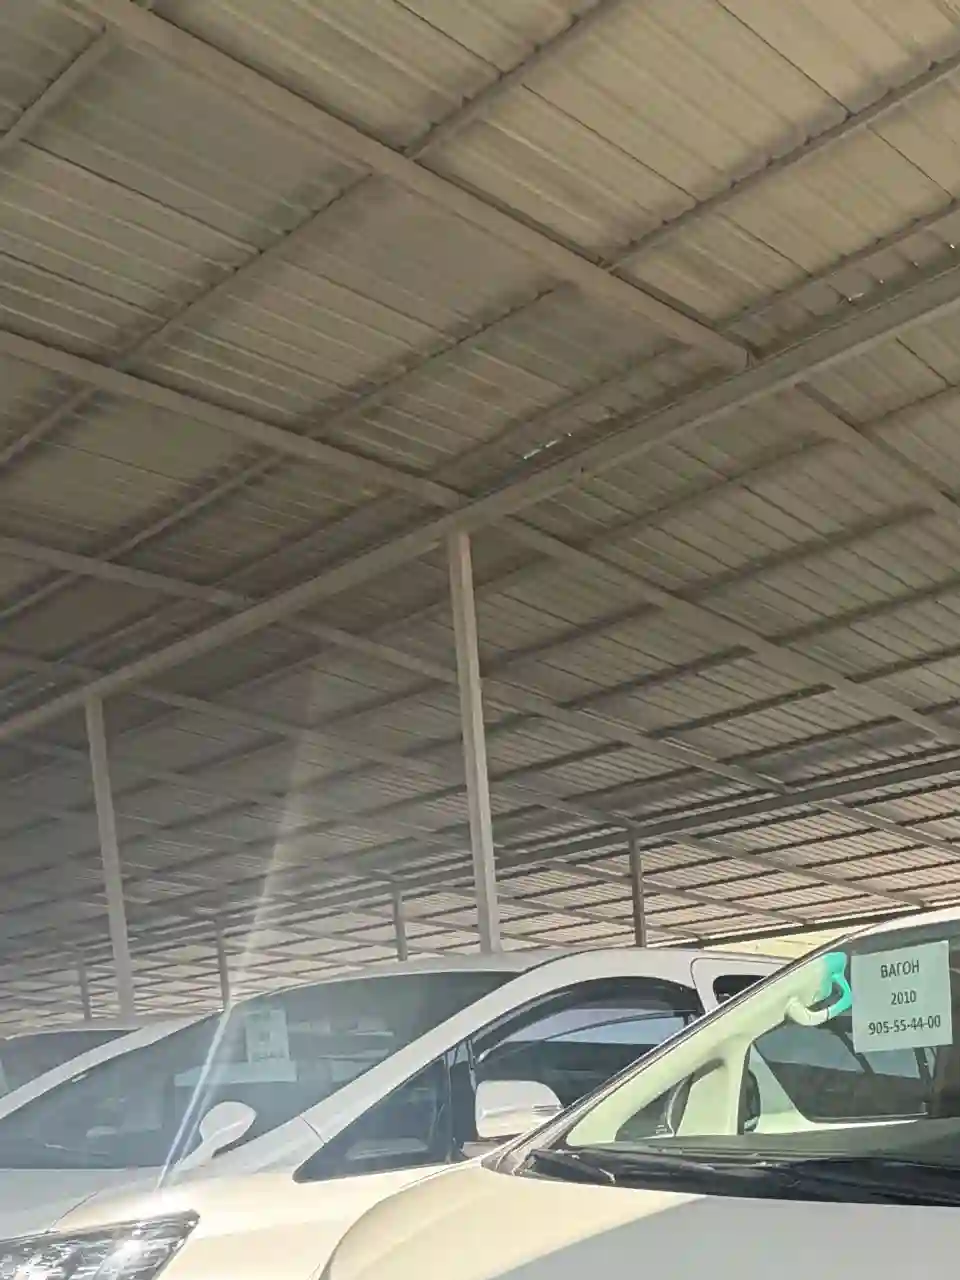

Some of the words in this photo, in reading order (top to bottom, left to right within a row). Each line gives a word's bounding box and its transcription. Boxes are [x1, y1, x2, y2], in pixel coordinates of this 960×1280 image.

[880, 959, 919, 978] ВАГОН
[891, 990, 917, 1005] 2010
[868, 1015, 941, 1035] 905-55-44-00
